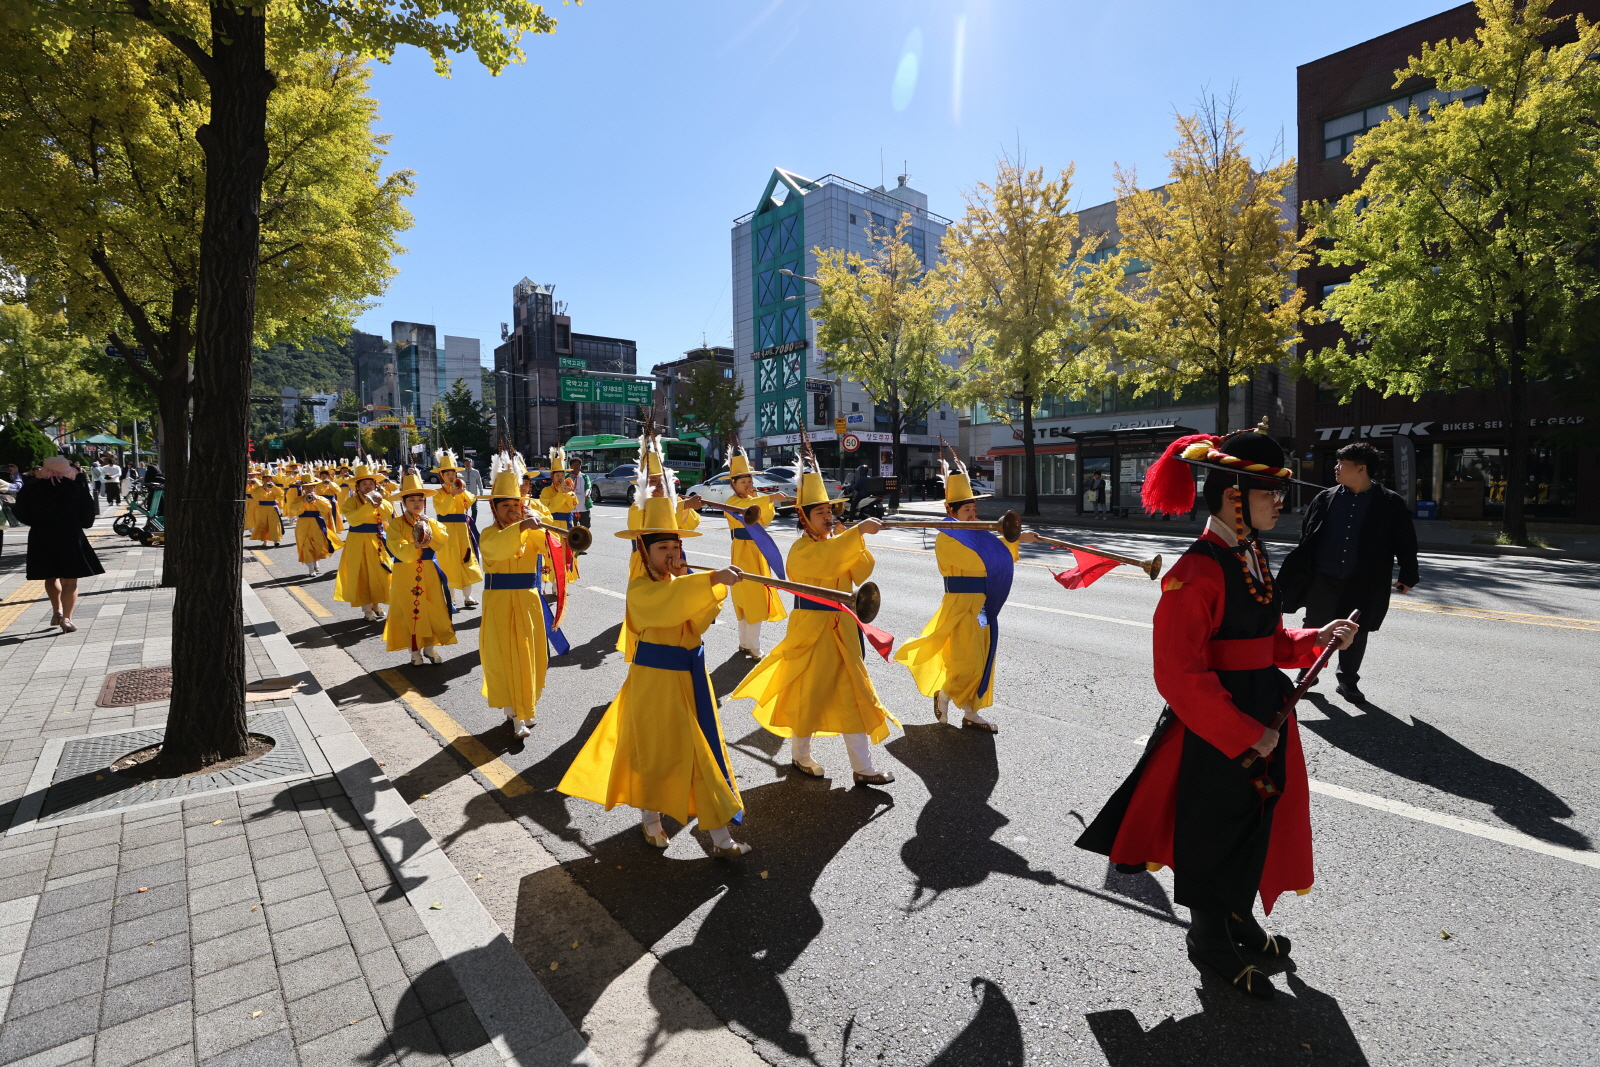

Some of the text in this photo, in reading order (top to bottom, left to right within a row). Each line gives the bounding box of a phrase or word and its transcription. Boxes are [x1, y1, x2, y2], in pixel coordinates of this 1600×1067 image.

[775, 342, 794, 355] 7080
[627, 384, 648, 392] 강남대로
[1442, 421, 1475, 431] BIKES
[1547, 415, 1585, 425] GEAR
[1315, 421, 1435, 441] TREK
[845, 438, 856, 447] 50
[1400, 445, 1409, 506] TREK
